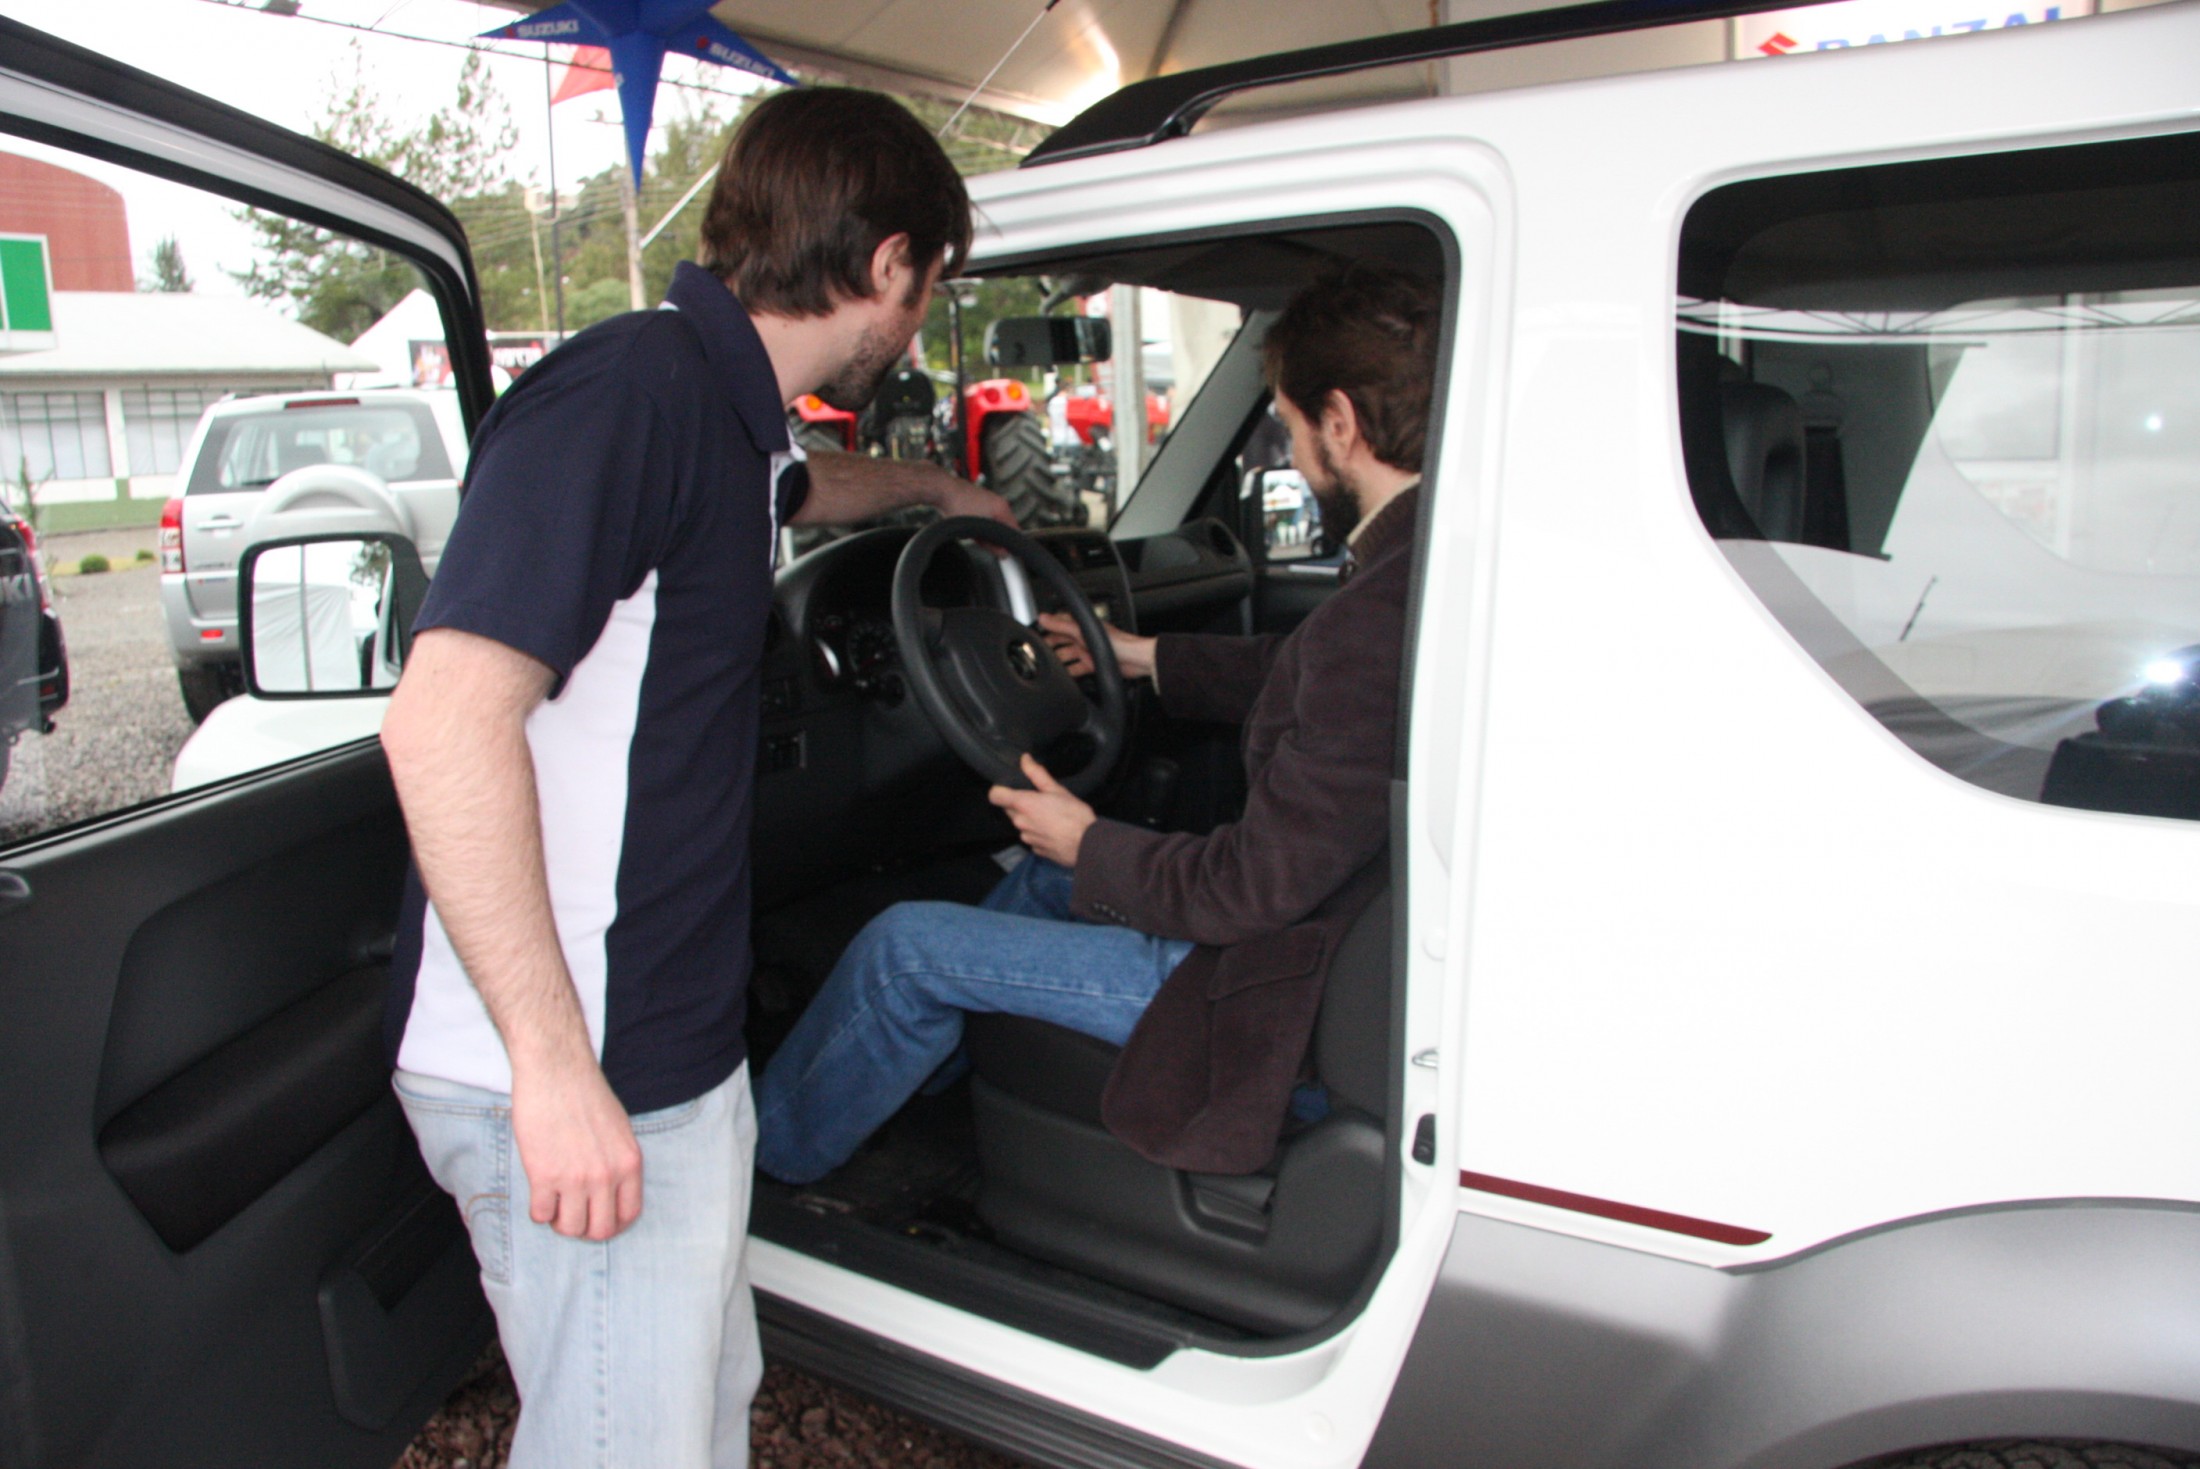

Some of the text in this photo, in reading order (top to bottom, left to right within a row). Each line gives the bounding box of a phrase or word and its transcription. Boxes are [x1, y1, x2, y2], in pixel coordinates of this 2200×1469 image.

[517, 20, 579, 38] SUZUKI
[709, 42, 775, 78] SUZUKI
[0, 573, 34, 602] KI
